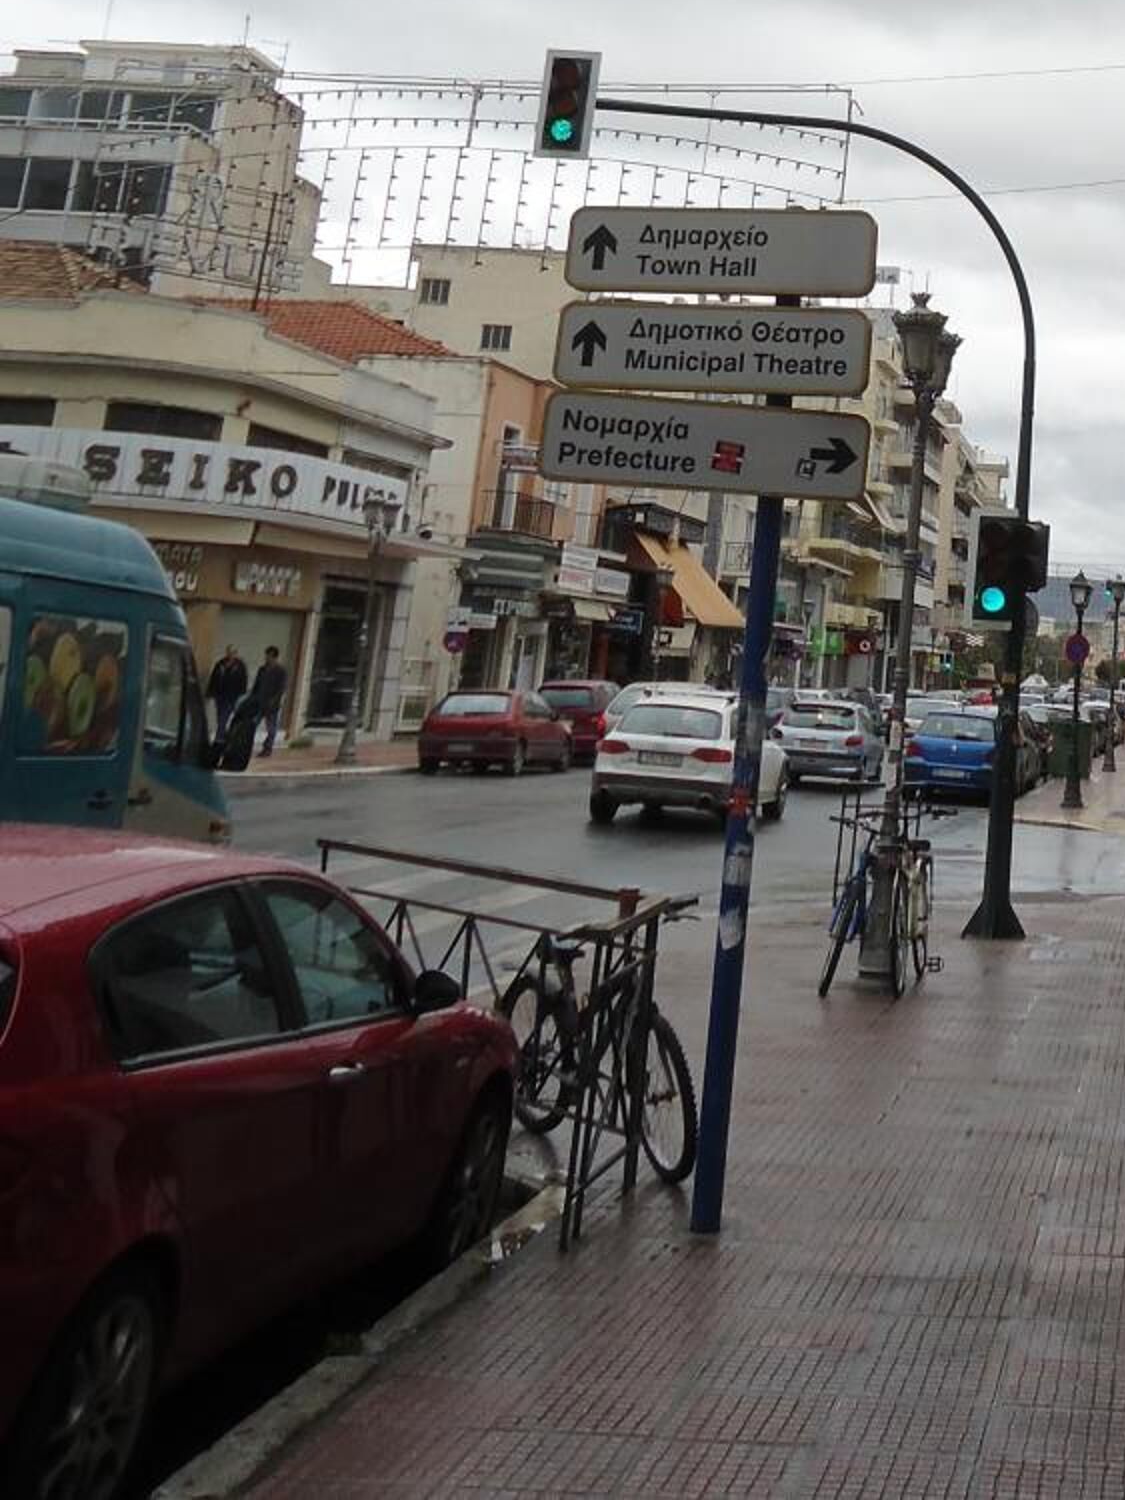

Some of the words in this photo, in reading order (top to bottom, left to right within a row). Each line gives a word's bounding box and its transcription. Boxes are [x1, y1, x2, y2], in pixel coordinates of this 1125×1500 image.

[639, 224, 768, 251] Δημαρχείο
[637, 255, 701, 276] Town
[709, 256, 757, 277] Hall
[629, 317, 743, 343] Δημοτικό
[751, 320, 845, 348] Θέατρο
[624, 349, 744, 377] Municipal
[754, 353, 847, 376] Theatre
[562, 408, 689, 442] Νομαρχία
[83, 443, 299, 499] SEIKO
[558, 442, 696, 474] Prefecture
